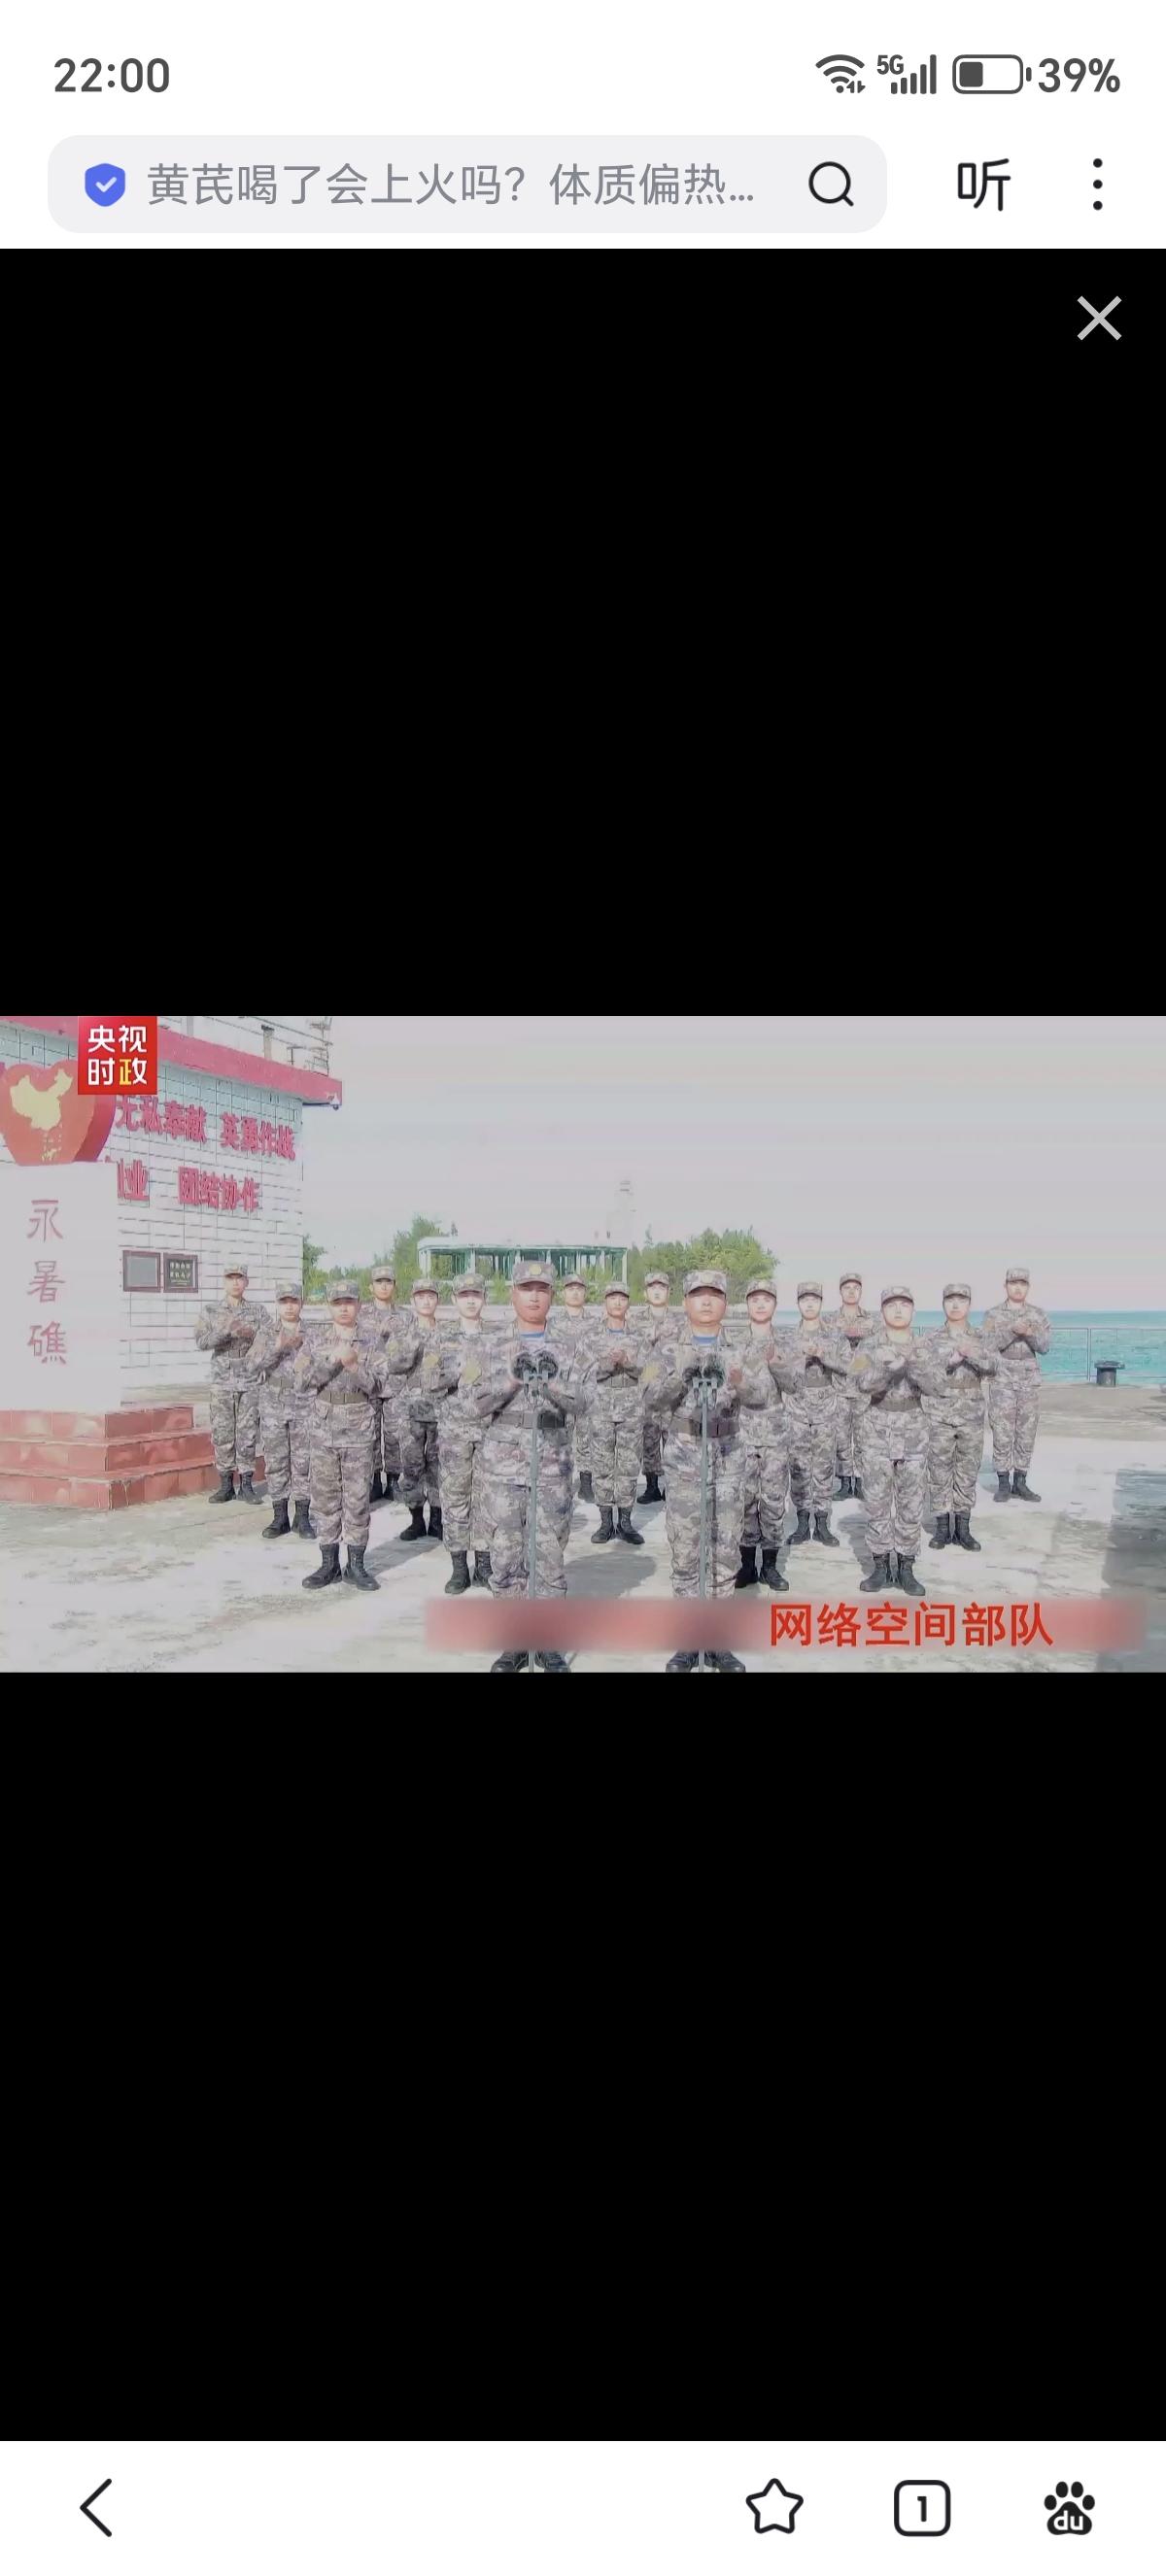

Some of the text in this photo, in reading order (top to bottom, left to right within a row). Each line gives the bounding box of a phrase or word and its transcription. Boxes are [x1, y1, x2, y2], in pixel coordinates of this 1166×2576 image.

[52, 57, 170, 94] 22:00
[875, 53, 906, 76] 5G
[1037, 57, 1122, 94] 39%
[956, 157, 1012, 212] 听
[178, 1166, 261, 1213] 团结协作
[27, 1199, 67, 1365] 永暑礁
[916, 2495, 928, 2523] 1
[1052, 2510, 1084, 2531] du
